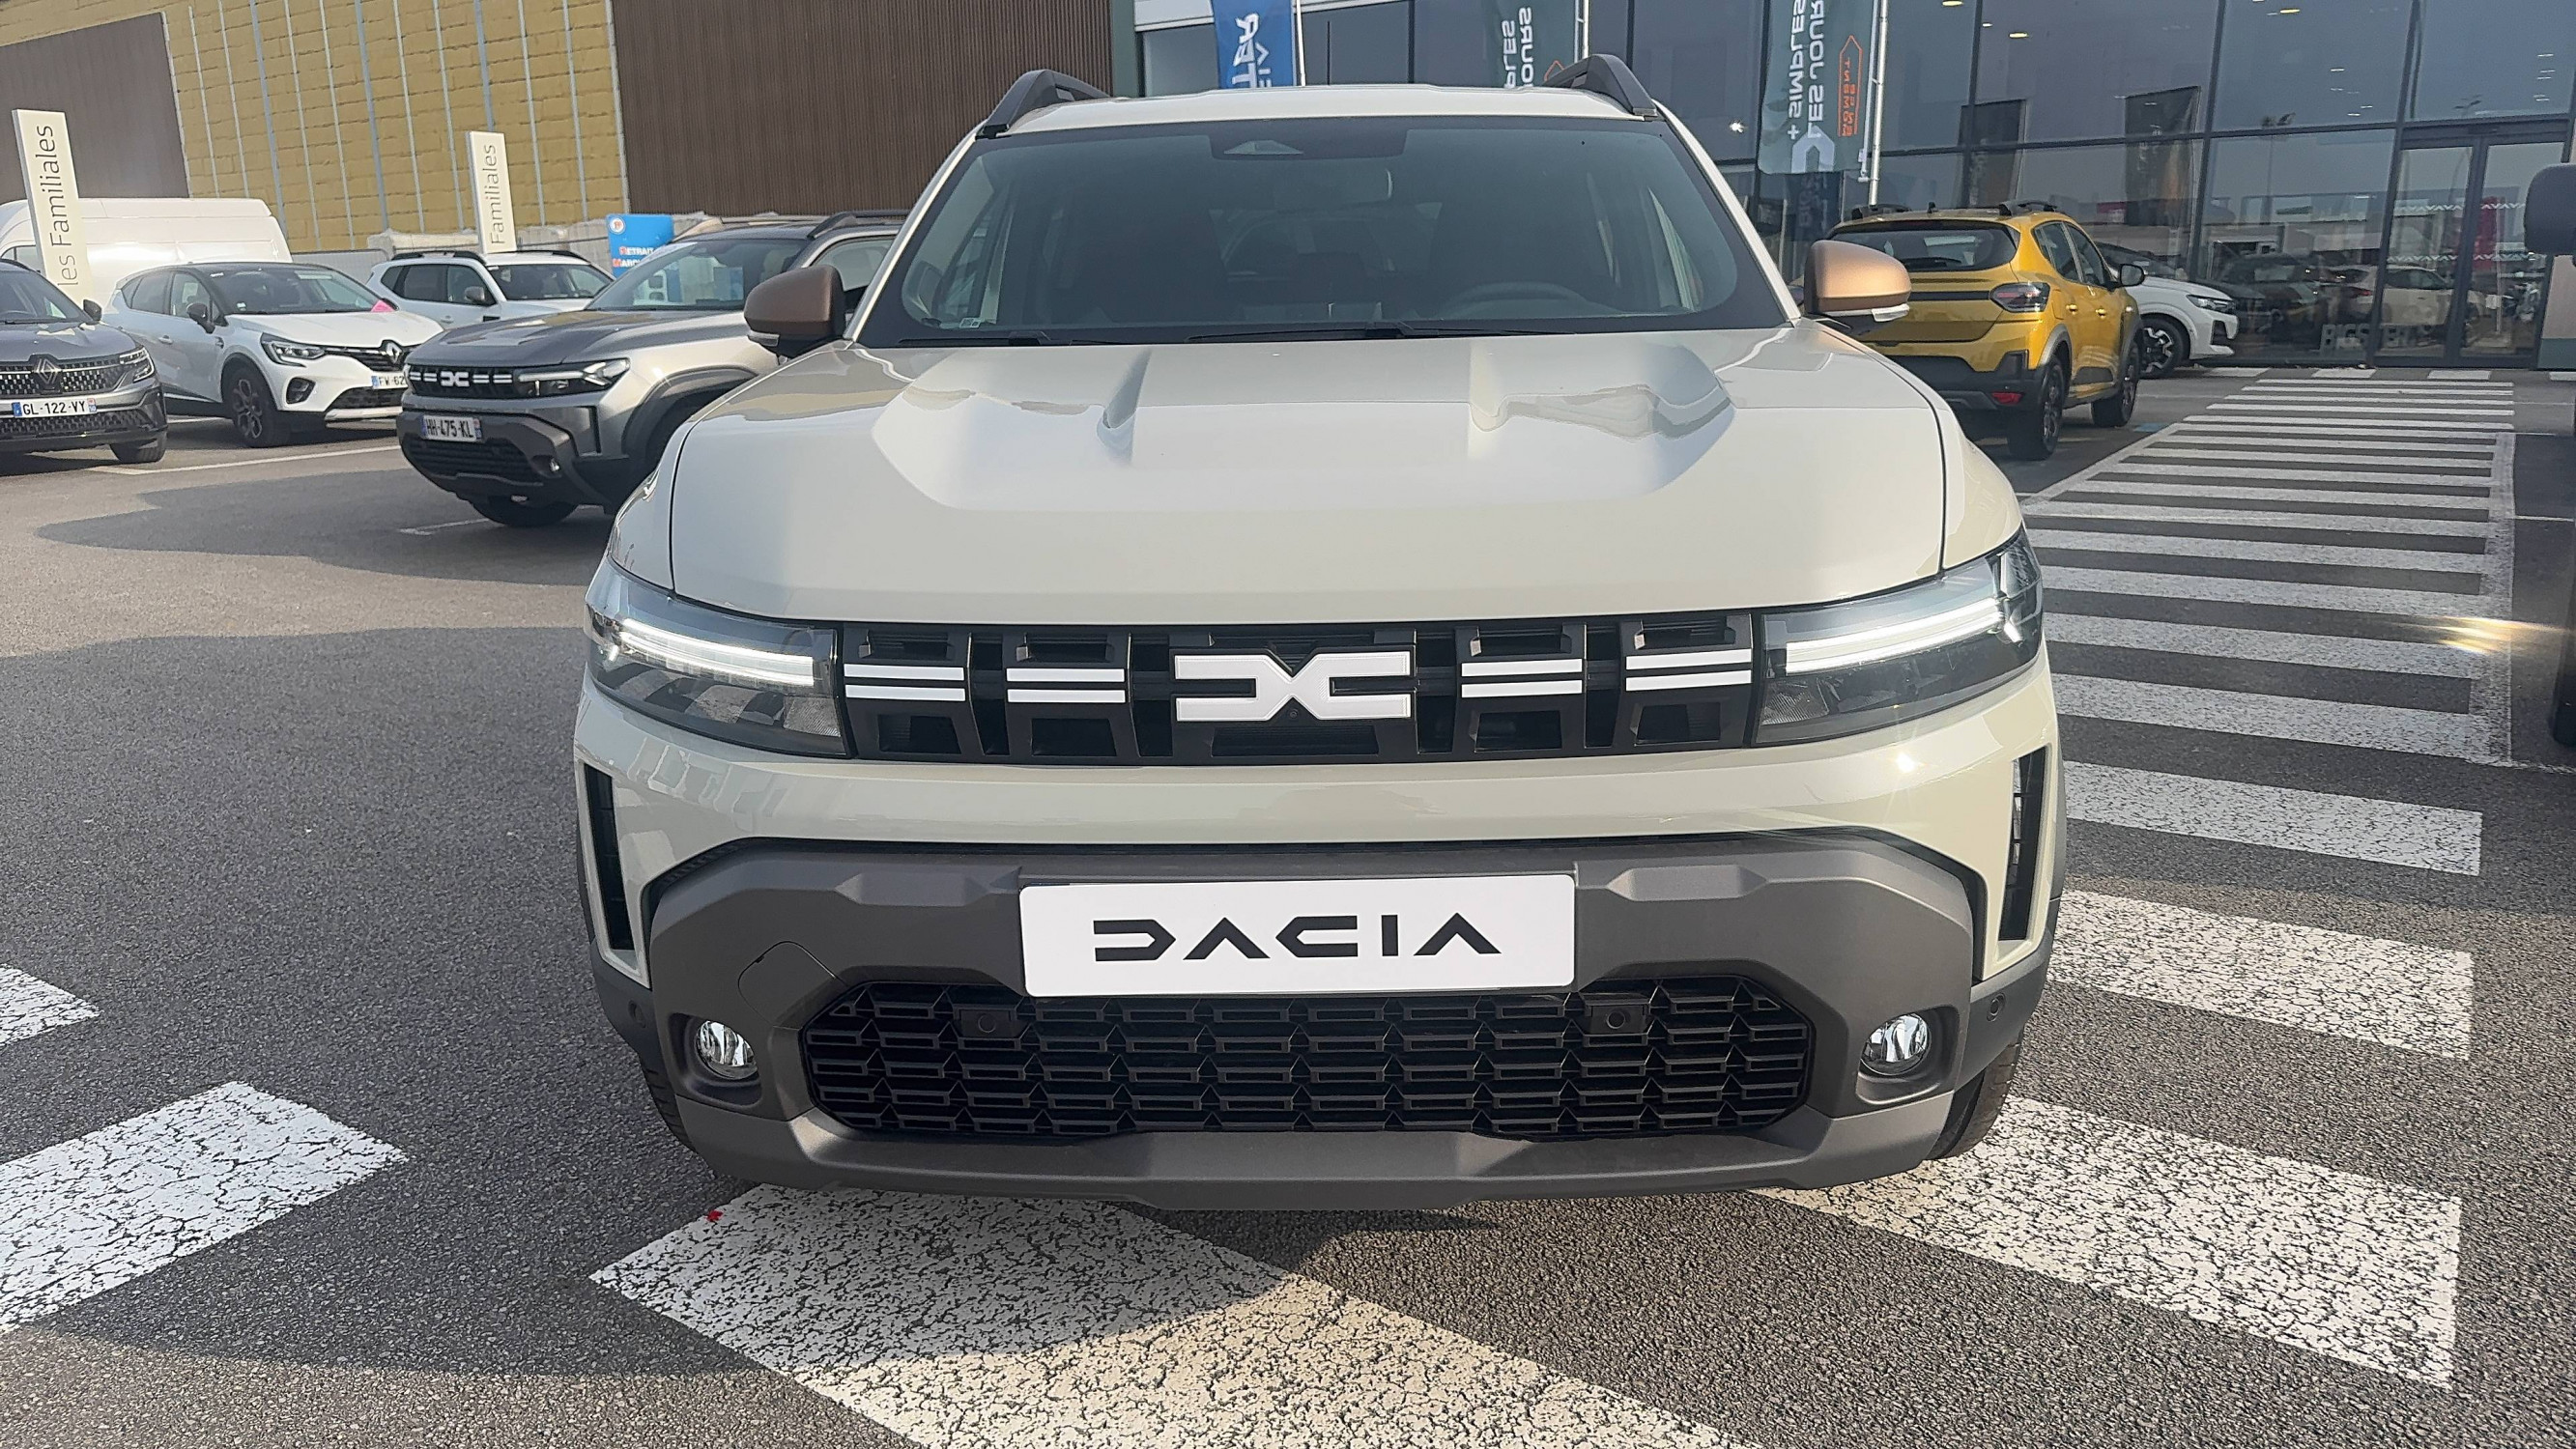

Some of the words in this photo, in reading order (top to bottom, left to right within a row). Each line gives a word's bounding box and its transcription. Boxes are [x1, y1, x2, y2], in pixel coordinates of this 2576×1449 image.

[35, 125, 72, 247] Familiales
[482, 144, 505, 244] Familiales
[57, 254, 79, 286] les
[22, 400, 85, 415] GL-122-VY
[1093, 912, 1502, 962] DACIA
